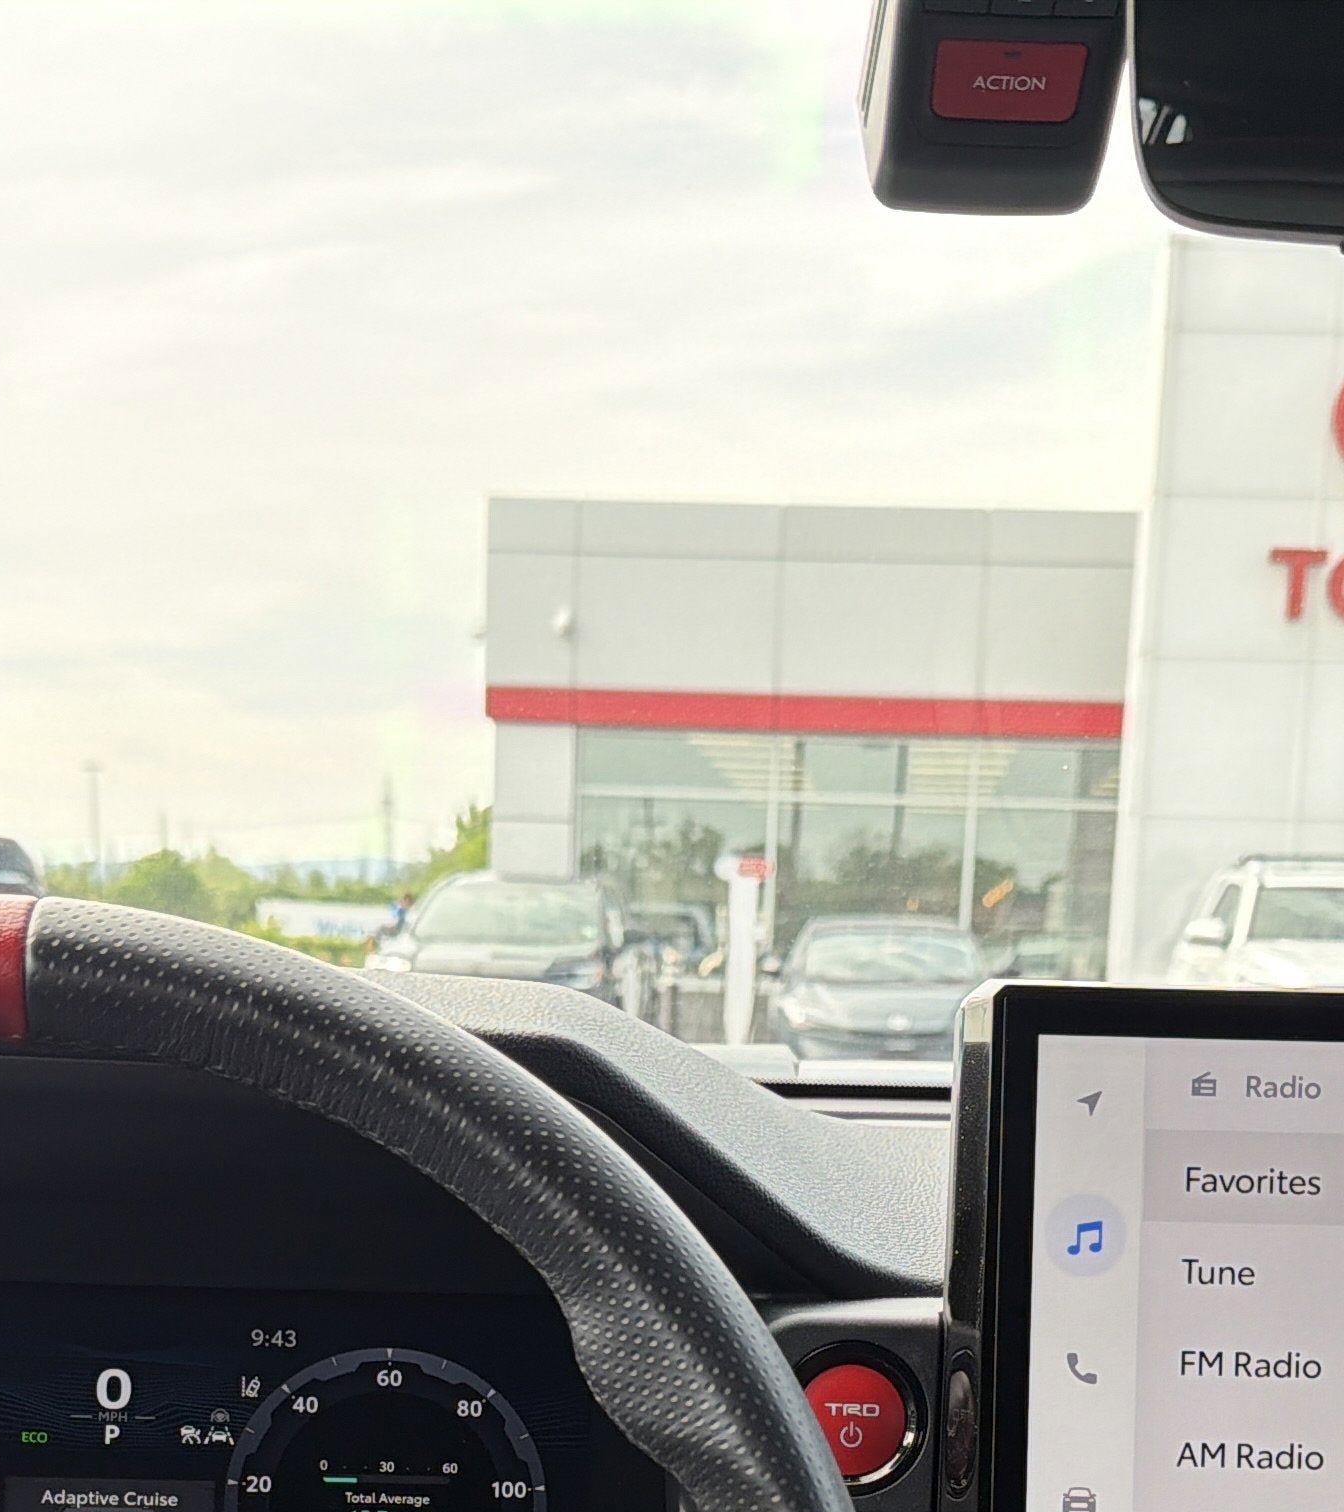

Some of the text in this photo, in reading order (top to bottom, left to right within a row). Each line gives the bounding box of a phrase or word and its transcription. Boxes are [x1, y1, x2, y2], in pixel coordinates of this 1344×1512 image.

[973, 75, 1046, 92] ACTION
[1245, 1075, 1322, 1100] Radio
[1185, 1167, 1321, 1196] Favorites
[1181, 1259, 1256, 1286] Tune
[250, 1329, 297, 1348] 9:43
[1180, 1350, 1322, 1379] FM Radio
[376, 1370, 402, 1387] 60
[96, 1368, 132, 1410] 0
[292, 1397, 318, 1414] 40
[456, 1400, 482, 1417] 80
[824, 1402, 880, 1417] TRD
[98, 1411, 128, 1422] MPH
[21, 1431, 48, 1443] ECO
[105, 1425, 120, 1445] P
[1176, 1442, 1324, 1471] AM Radio
[320, 1459, 458, 1474] 0 30 60
[246, 1476, 272, 1493] 20
[491, 1481, 527, 1499] 100
[41, 1490, 179, 1508] Adaptive Cruise
[345, 1492, 430, 1506] Total Average
